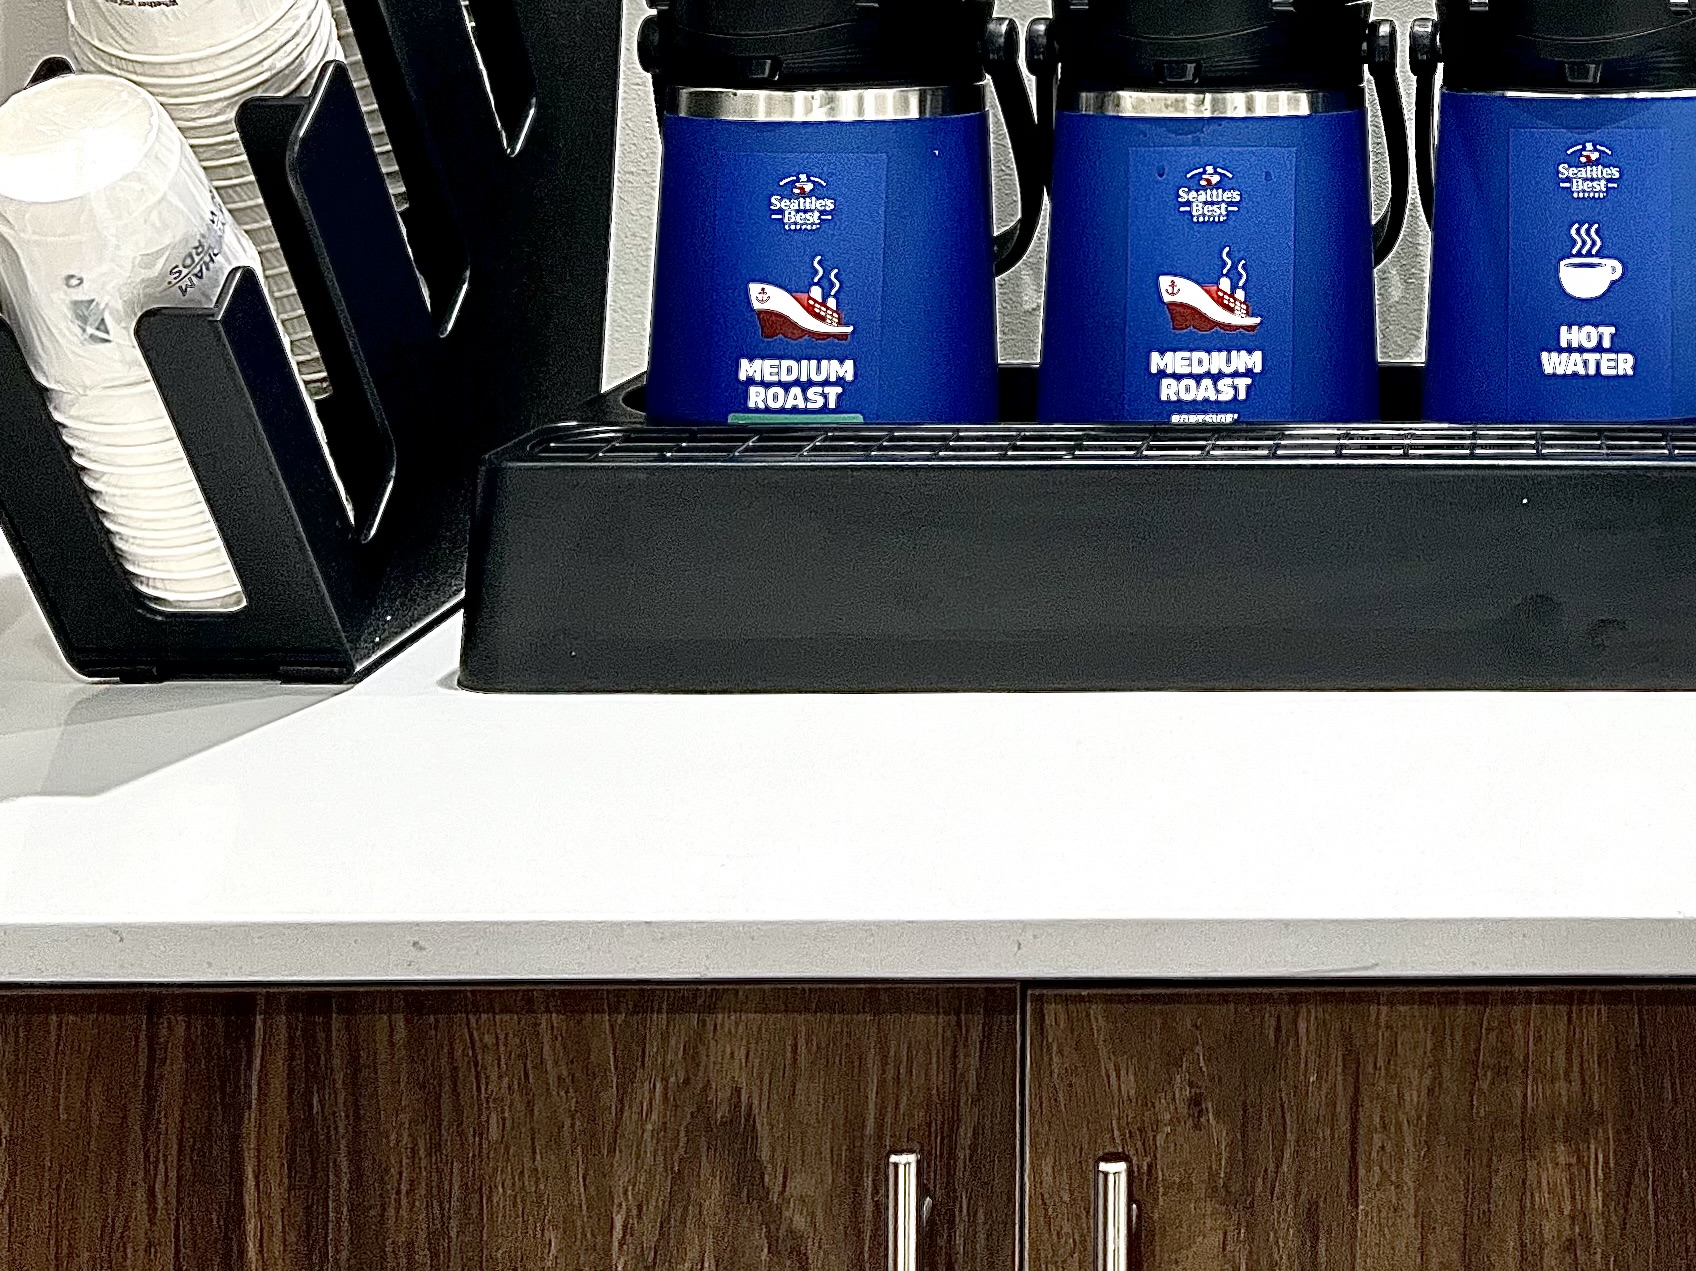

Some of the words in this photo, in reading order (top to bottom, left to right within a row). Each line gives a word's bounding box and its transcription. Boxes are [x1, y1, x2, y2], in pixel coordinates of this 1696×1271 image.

[1558, 163, 1620, 178] Seattle's
[1178, 187, 1241, 202] Seattle's
[1571, 178, 1607, 192] Best
[770, 195, 835, 211] Seattle's
[1191, 202, 1227, 215] Best
[783, 210, 820, 224] Best
[1560, 325, 1616, 349] HOT
[739, 358, 855, 382] MEDIUM
[1150, 350, 1263, 374] MEDIUM
[1540, 351, 1635, 376] WATER
[748, 385, 843, 409] ROAST
[1160, 377, 1252, 401] ROAST
